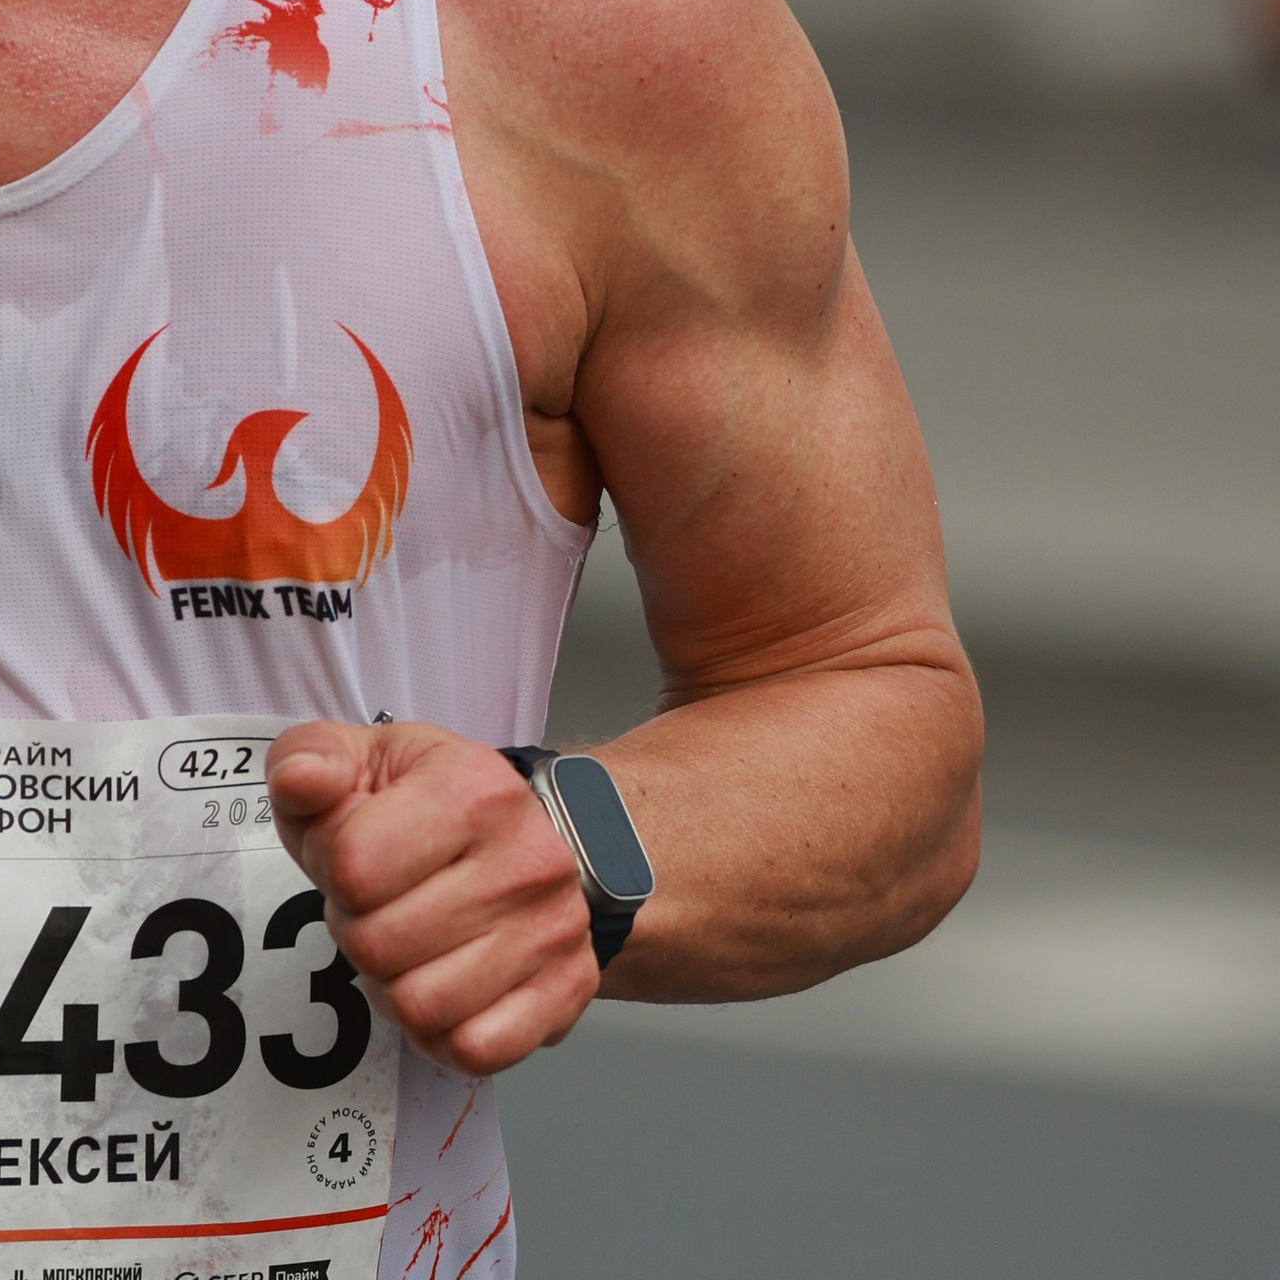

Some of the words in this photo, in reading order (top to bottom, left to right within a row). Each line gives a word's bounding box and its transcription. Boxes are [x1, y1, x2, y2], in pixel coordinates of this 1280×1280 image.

[170, 586, 270, 621] FENIX
[274, 586, 353, 622] TEAM
[179, 746, 253, 781] 42,2
[202, 795, 273, 829] 202
[306, 1116, 327, 1149] БЕГУ
[328, 1132, 352, 1163] 4
[331, 1107, 377, 1177] МОСКОВСКИЙ
[306, 1154, 357, 1190] МАРАФОН
